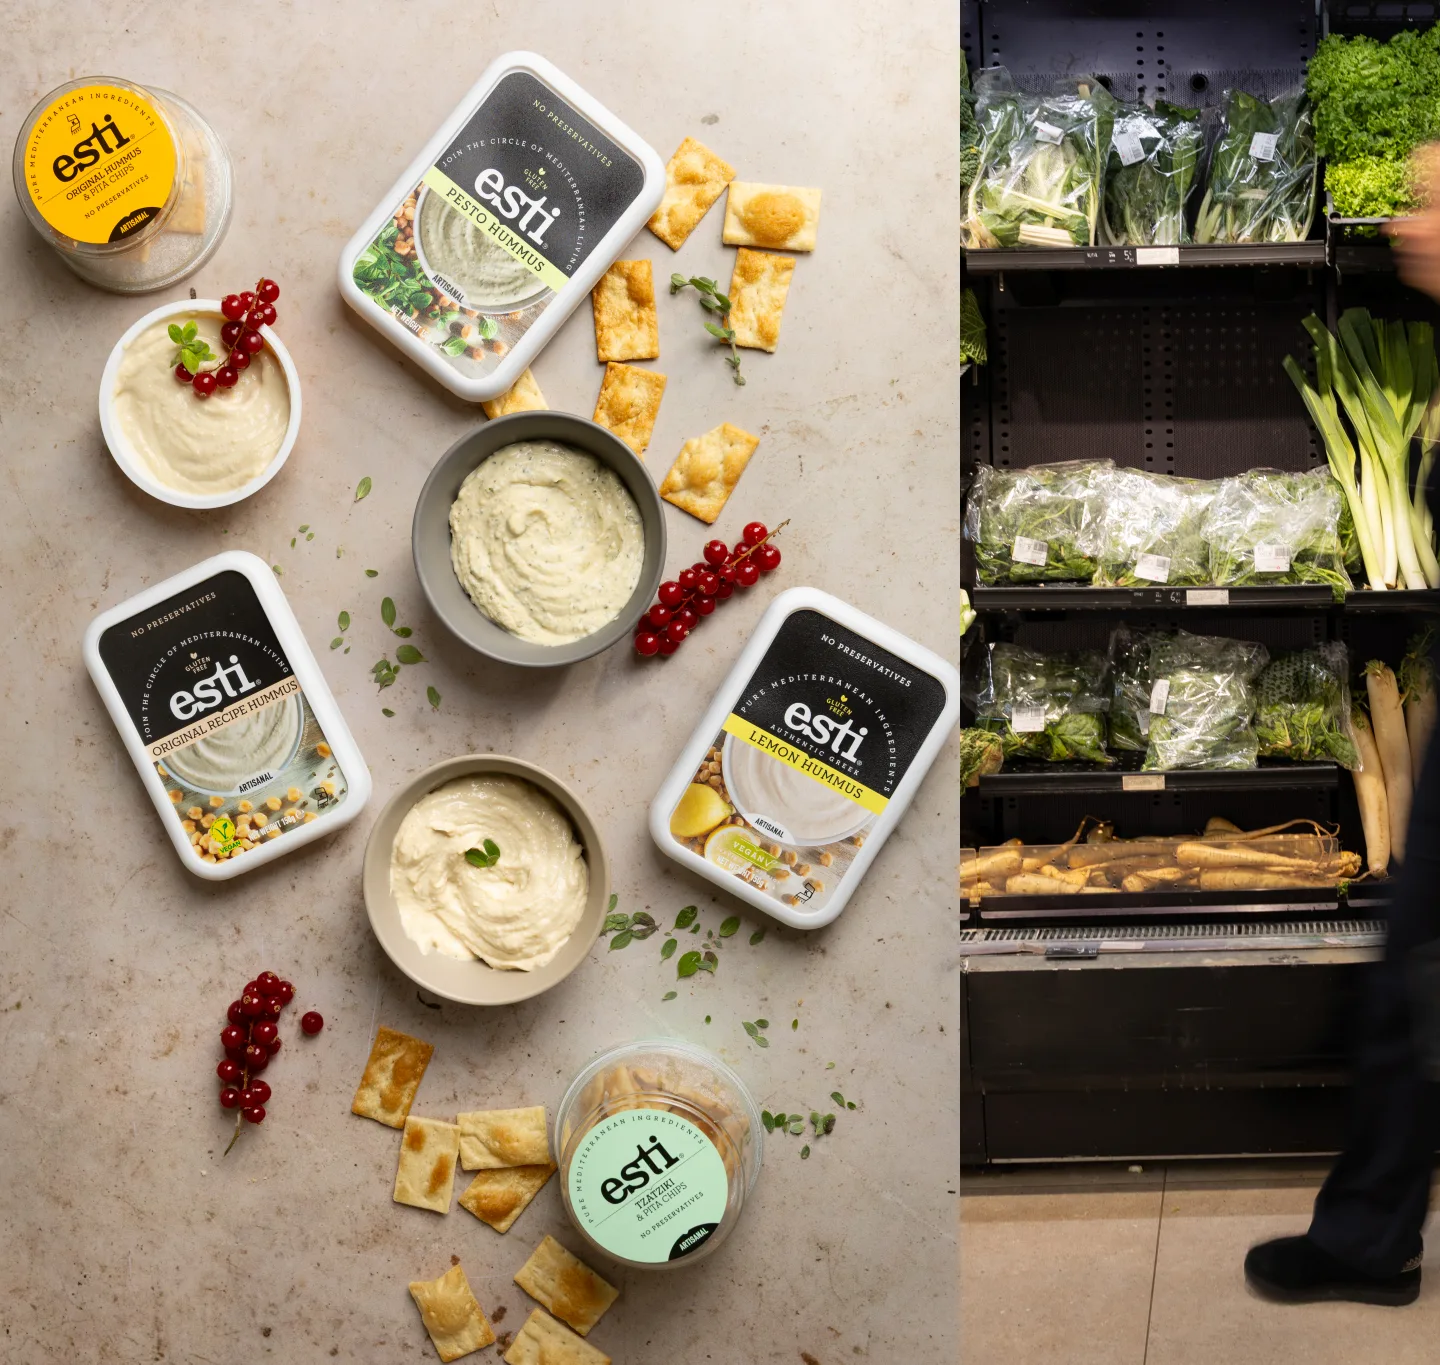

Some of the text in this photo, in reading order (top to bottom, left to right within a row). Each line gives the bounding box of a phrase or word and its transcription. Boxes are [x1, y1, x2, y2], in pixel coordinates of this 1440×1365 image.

[30, 93, 155, 200] PURE MEDITERRANEAN INGREDIENTS
[53, 114, 130, 182] esti
[533, 99, 613, 168] NO PRESERVATIVES
[66, 147, 142, 201] ORIGINAL HUMMUS
[83, 163, 135, 201] & PITA CHIPS
[84, 174, 149, 219] NO PRESERVATIVES
[523, 168, 548, 190] GLUTEN
[525, 177, 539, 191] FREE
[120, 211, 150, 234] ARTISANAL
[442, 137, 585, 271] JOIN THE CIRCLE OF MEDITERRANEAN LIVING
[474, 168, 561, 246] esti
[446, 187, 545, 272] PESTO HUMMUS
[432, 274, 465, 303] ARTISANAL
[391, 304, 403, 317] NET
[400, 313, 421, 333] WEIGHT
[130, 591, 217, 638] NO PRESERVATIVES
[185, 656, 211, 672] GLUTEN
[193, 663, 208, 675] FREE
[820, 633, 912, 687] NO PRESERVATIVES
[142, 630, 289, 738] JOIN THE CIRCLE OF MEDITERRANEAN LIVING
[169, 654, 257, 721] esti
[826, 698, 853, 716] GLUTEN
[152, 680, 298, 757] ORIGINAL RECIPE HUMMUS
[741, 673, 896, 792] PURE MEDITERRANEAN INGREDIENTS
[784, 702, 869, 763] esti
[828, 705, 845, 717] FREE
[749, 730, 864, 799] LEMON HUMMUS
[770, 724, 860, 776] AUTHENTIC GREEK
[238, 772, 273, 794] ARTISANAL
[219, 839, 242, 854] VEGAN
[755, 818, 784, 838] ARTISANAL
[733, 841, 765, 863] VEGAN
[577, 1115, 703, 1223] PURE MEDITERRANEAN INGREDIENTS
[601, 1135, 680, 1205] esti
[635, 1178, 675, 1210] TZATZIKI
[637, 1182, 688, 1222] & PITA CHIPS
[640, 1191, 704, 1239] NO PRESERVATIVES
[679, 1227, 709, 1251] ARTISANAL
